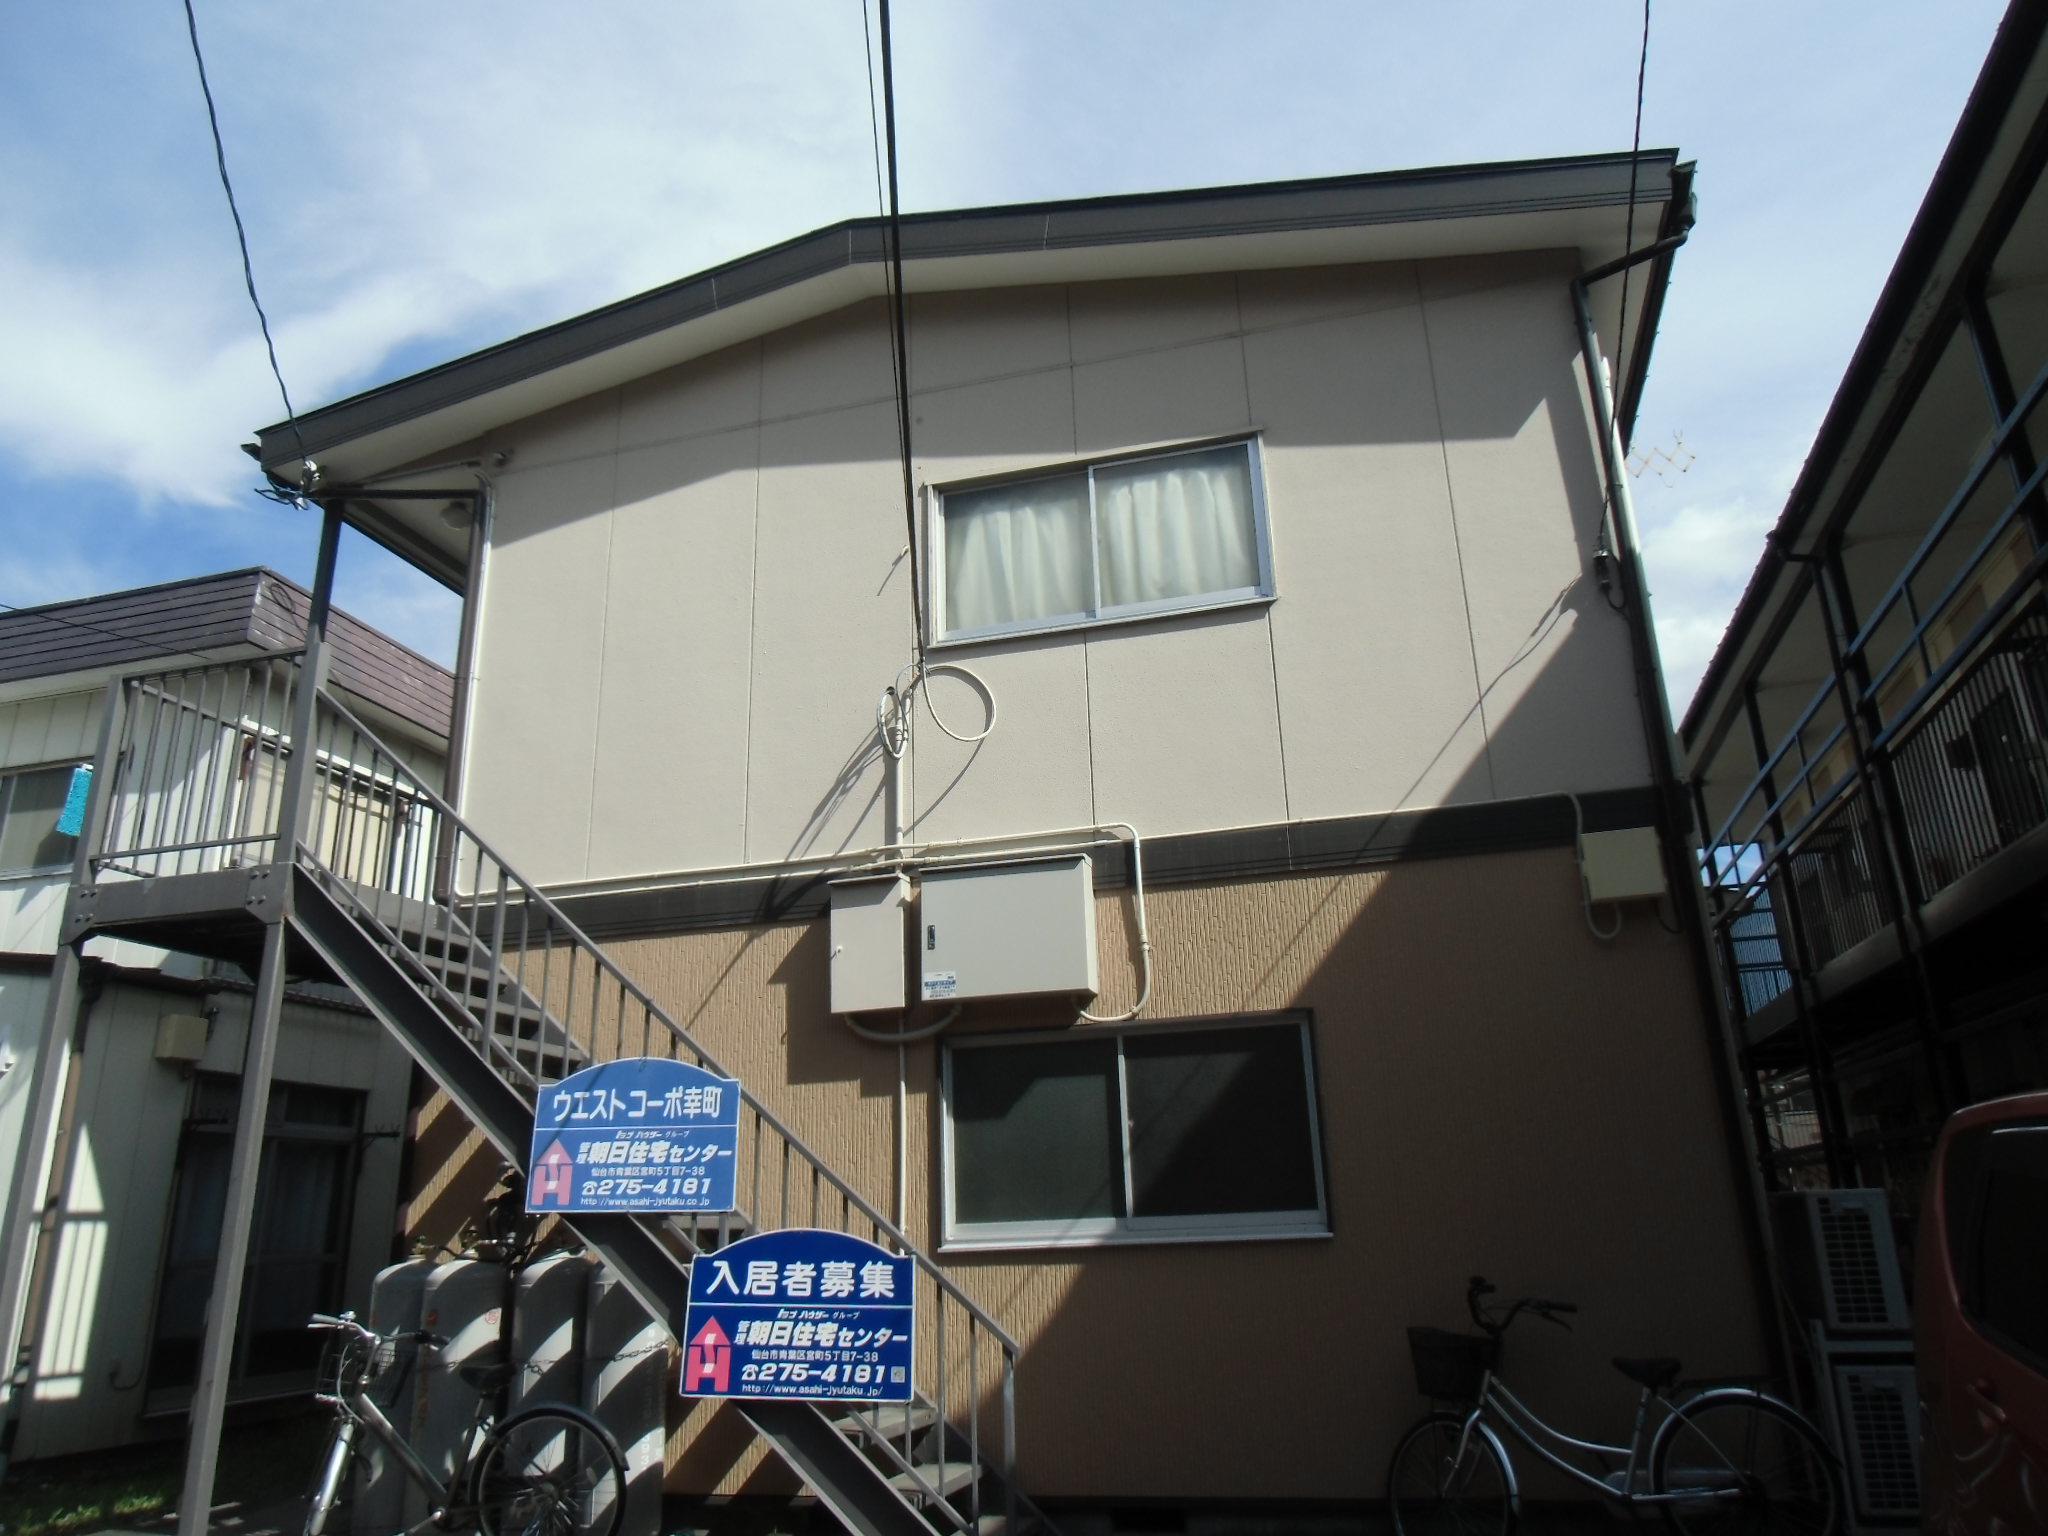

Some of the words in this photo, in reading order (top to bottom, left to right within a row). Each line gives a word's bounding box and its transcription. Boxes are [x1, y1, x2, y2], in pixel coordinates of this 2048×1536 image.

[553, 1086, 722, 1121] ウエストコーポ幸町
[706, 1260, 895, 1298] 入居者募集
[758, 1364, 885, 1384] 275-4181
